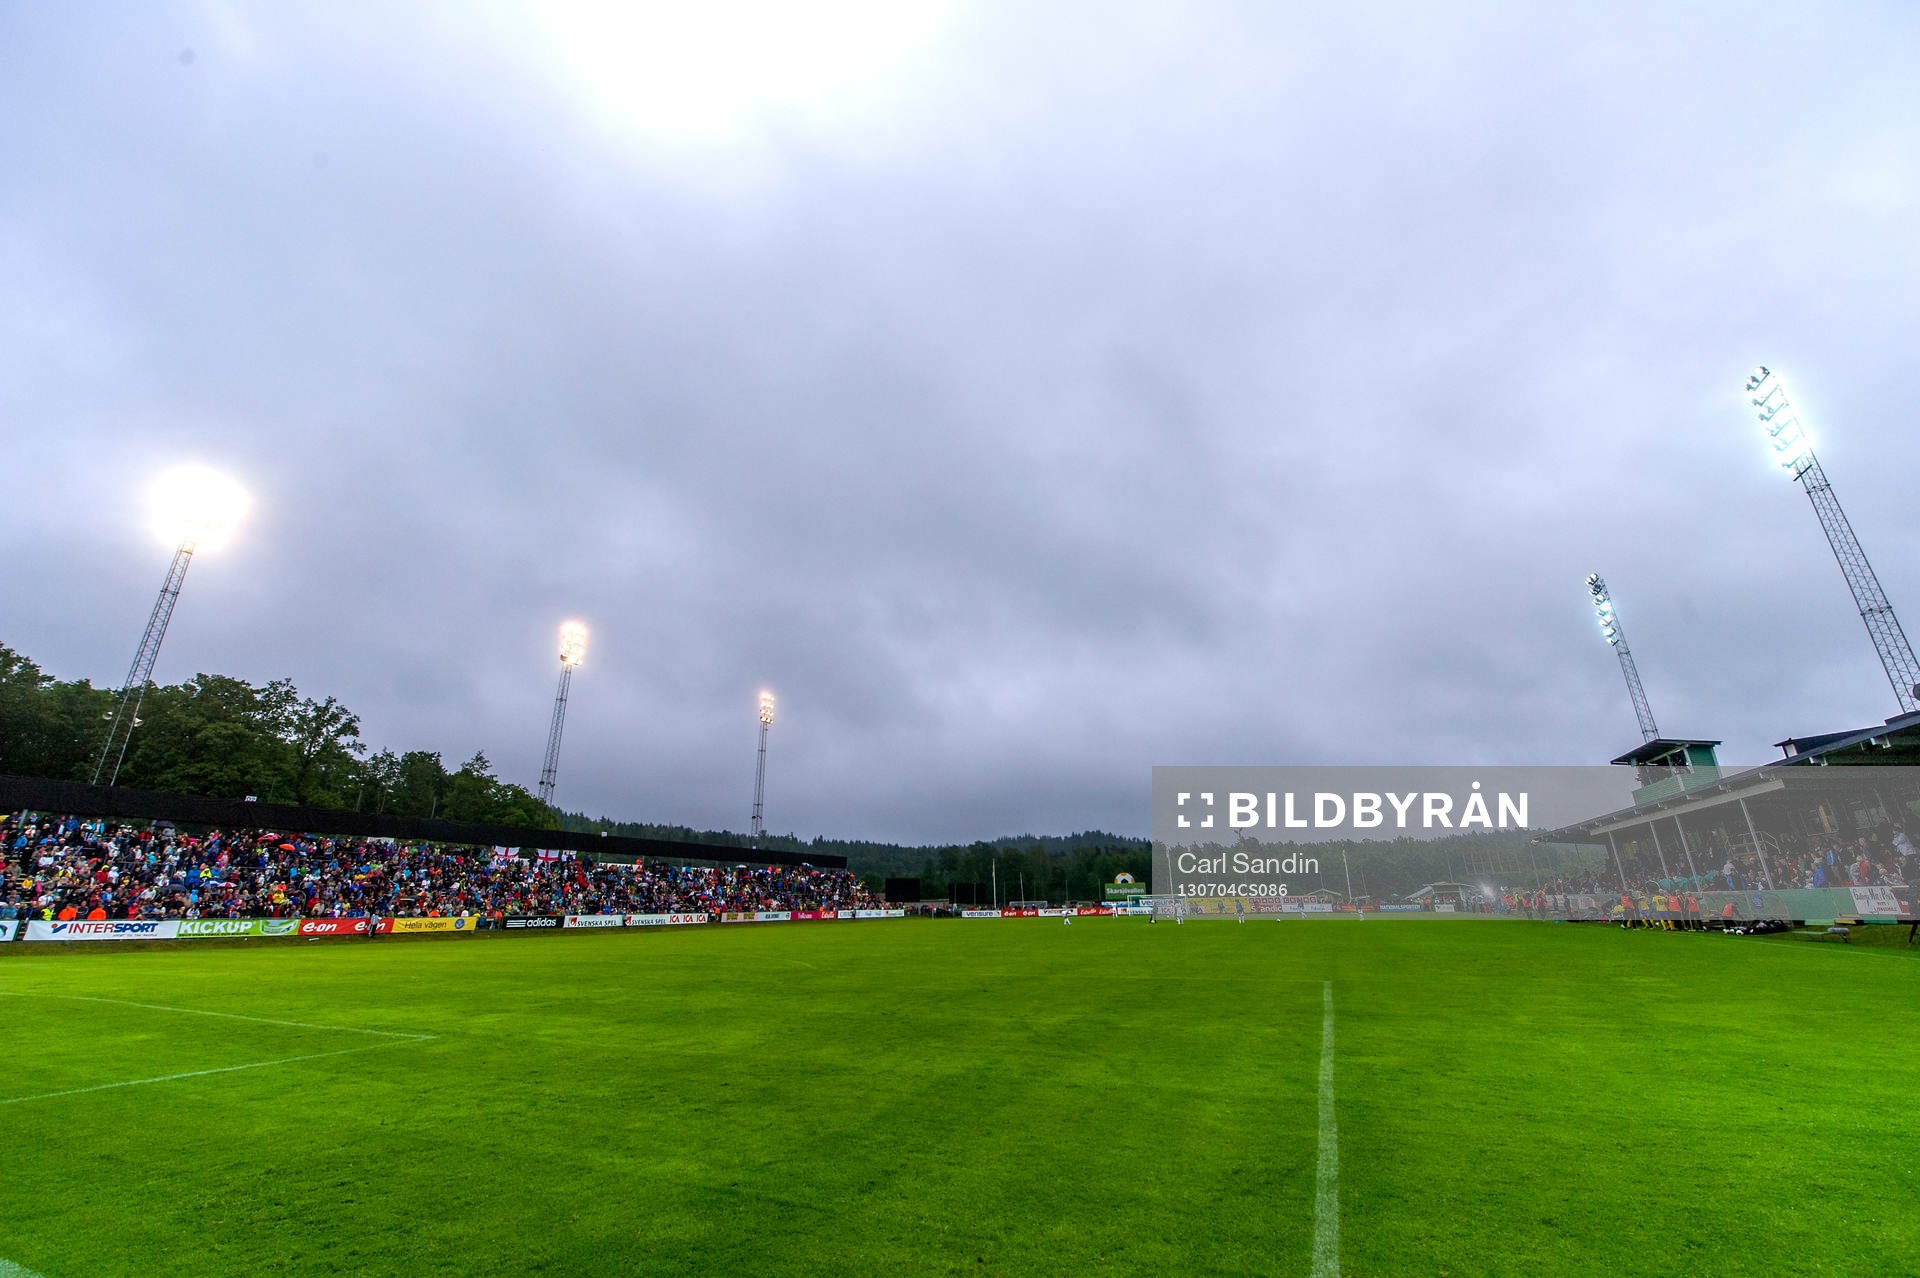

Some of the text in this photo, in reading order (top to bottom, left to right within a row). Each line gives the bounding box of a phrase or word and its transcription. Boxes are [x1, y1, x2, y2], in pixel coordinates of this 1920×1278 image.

[526, 917, 557, 927] adidas
[669, 915, 680, 923] ICA
[682, 915, 693, 923] ICA
[696, 914, 706, 922] ICA
[68, 922, 158, 934] INTERSPORT
[179, 921, 253, 934] KICKUP
[404, 921, 447, 930] Hela vägen
